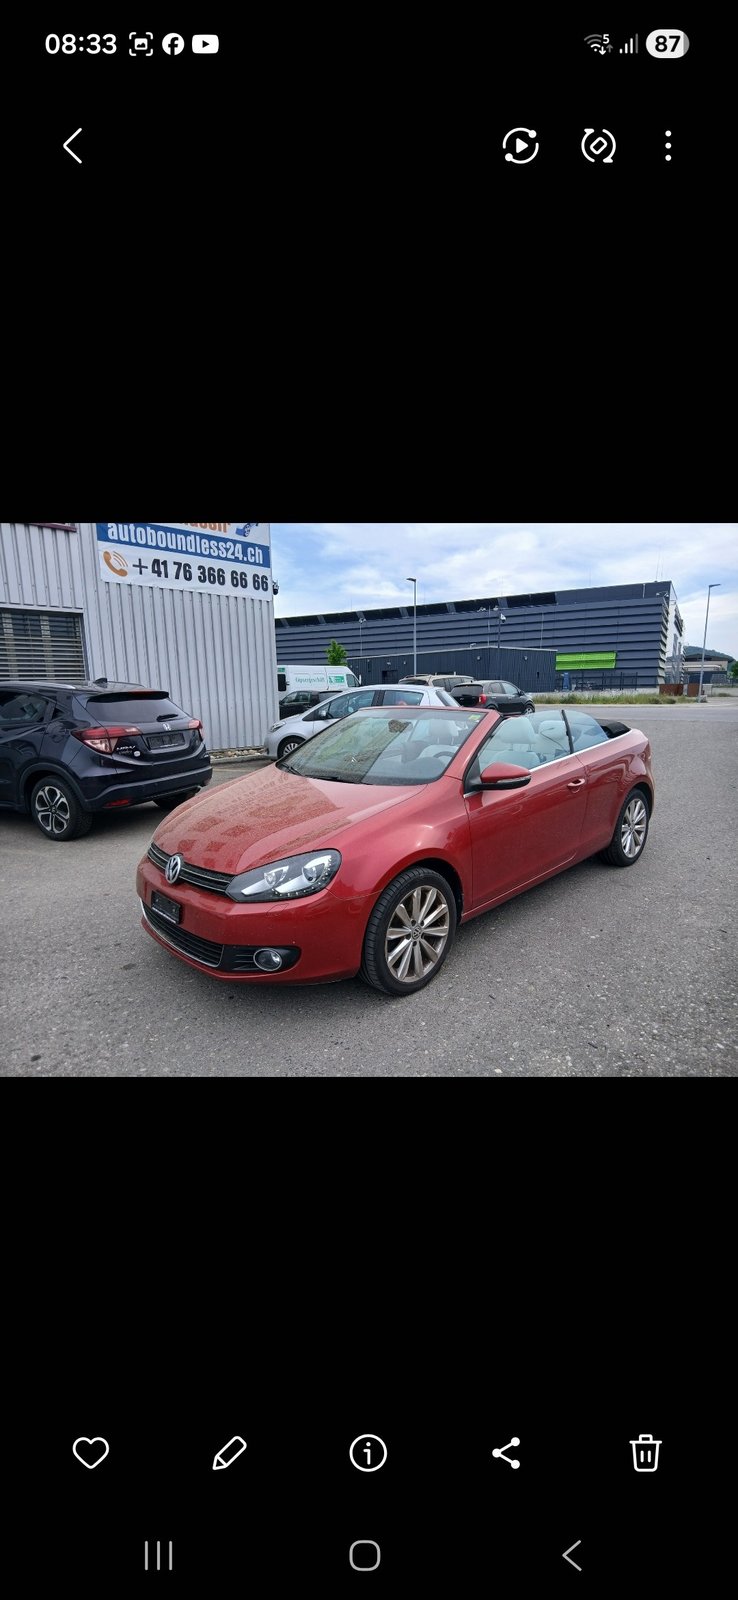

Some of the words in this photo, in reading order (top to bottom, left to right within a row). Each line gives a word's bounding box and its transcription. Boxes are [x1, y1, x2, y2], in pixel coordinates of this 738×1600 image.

[107, 523, 263, 564] autoboundless24.ch
[173, 561, 193, 581] 76
[197, 565, 226, 586] 366
[230, 570, 248, 589] 66
[252, 573, 269, 592] 66
